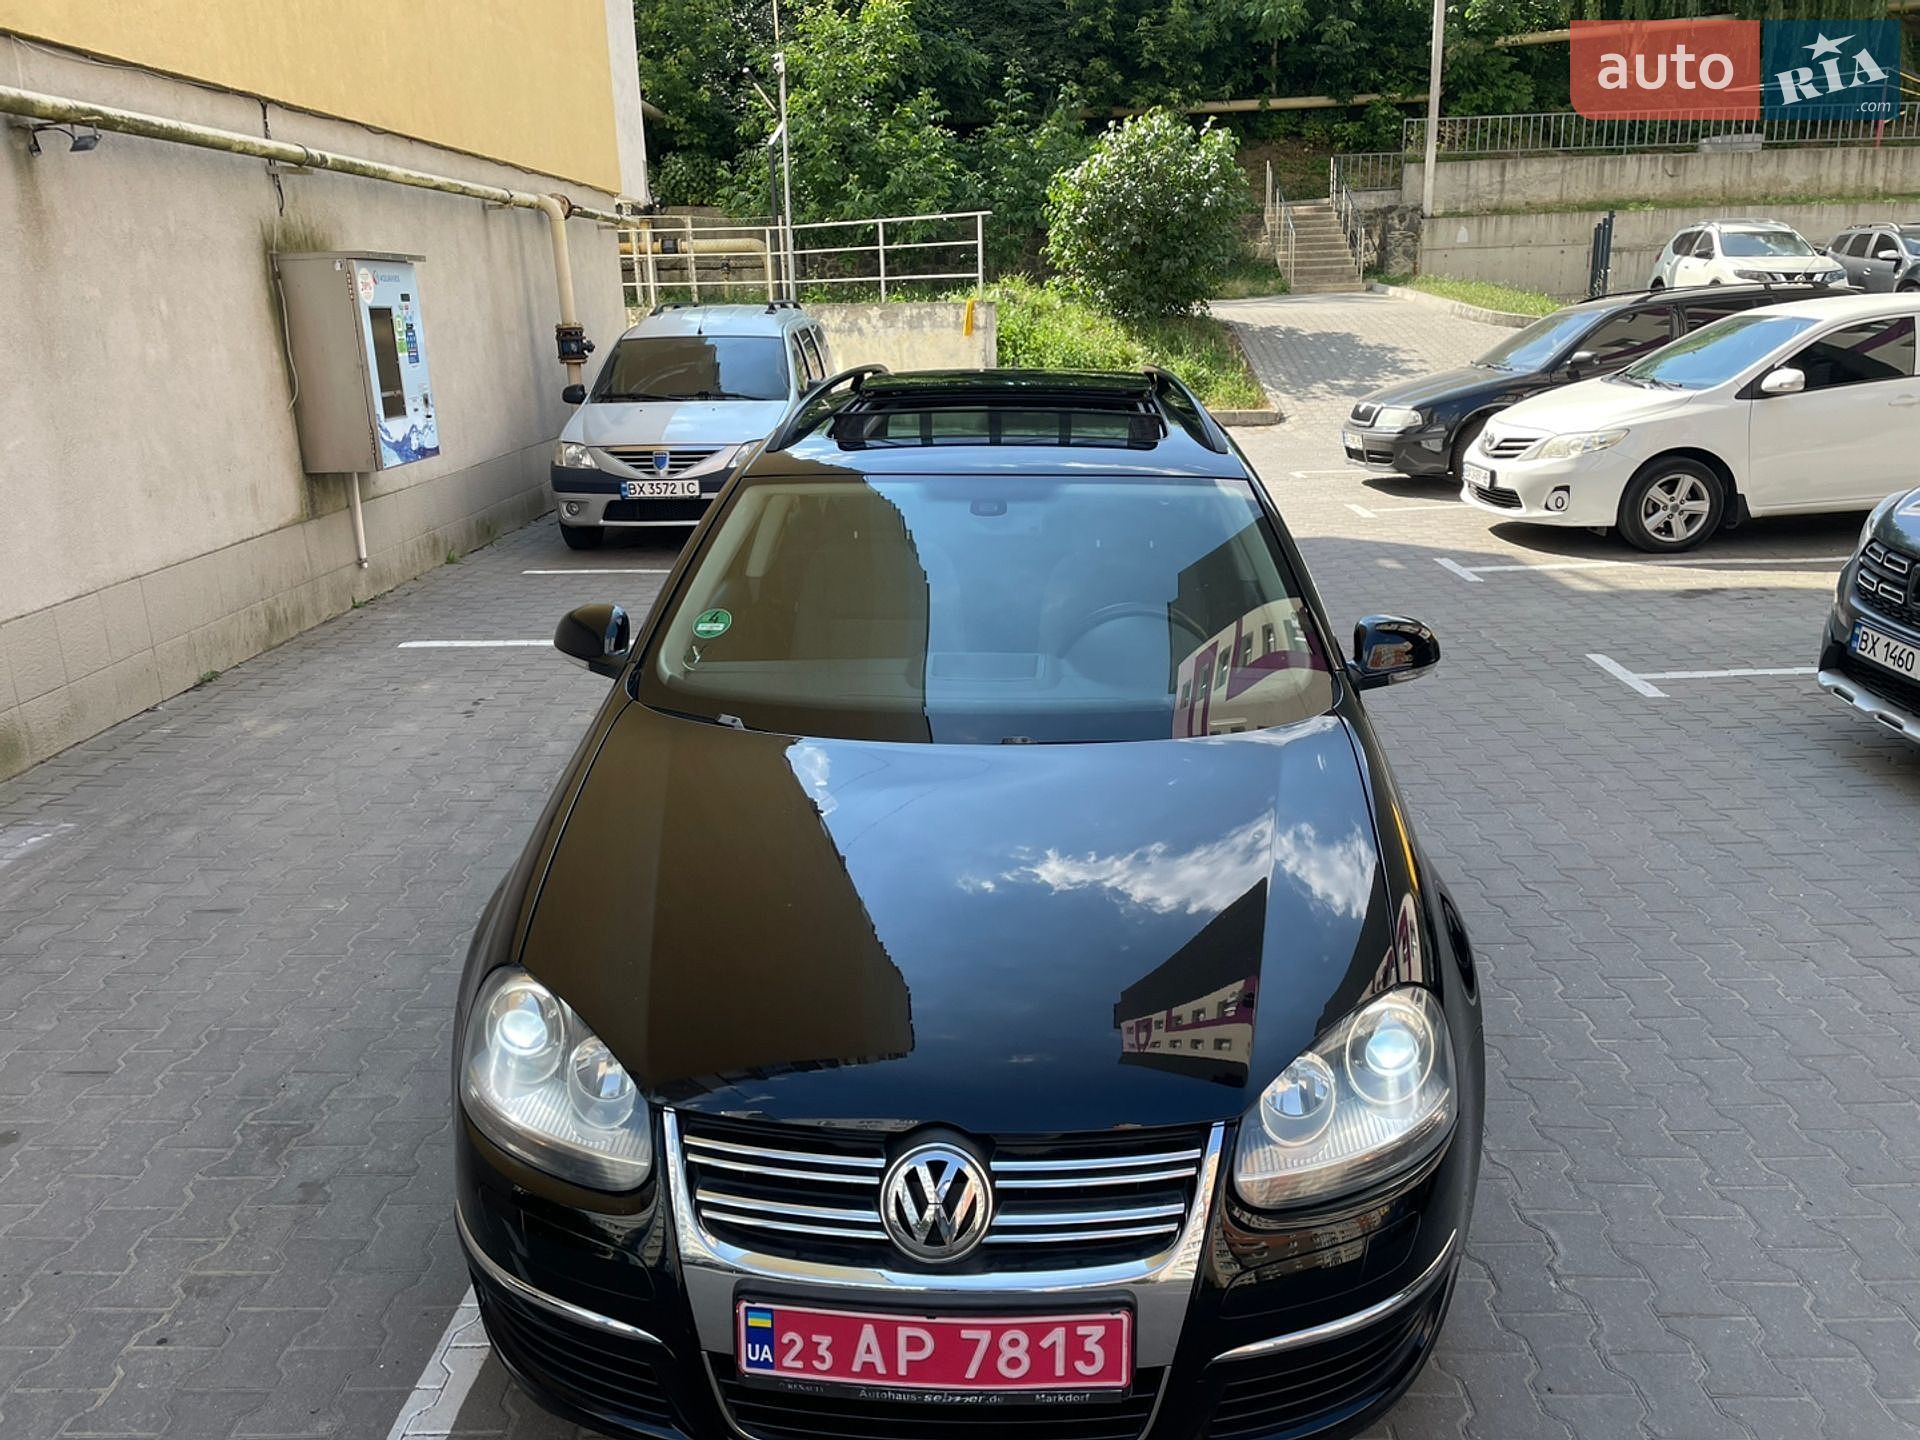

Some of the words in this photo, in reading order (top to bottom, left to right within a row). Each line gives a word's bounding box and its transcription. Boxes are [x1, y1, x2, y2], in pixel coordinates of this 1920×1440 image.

[628, 483, 646, 495] BX
[648, 482, 677, 495] 3572
[681, 482, 696, 494] IC
[1859, 630, 1880, 657] BX
[1884, 641, 1915, 672] 1460
[747, 1343, 773, 1363] UA
[780, 1331, 834, 1372] 23
[851, 1323, 936, 1377] AP
[960, 1325, 1106, 1380] 7813
[1034, 1392, 1091, 1403] Markdorf
